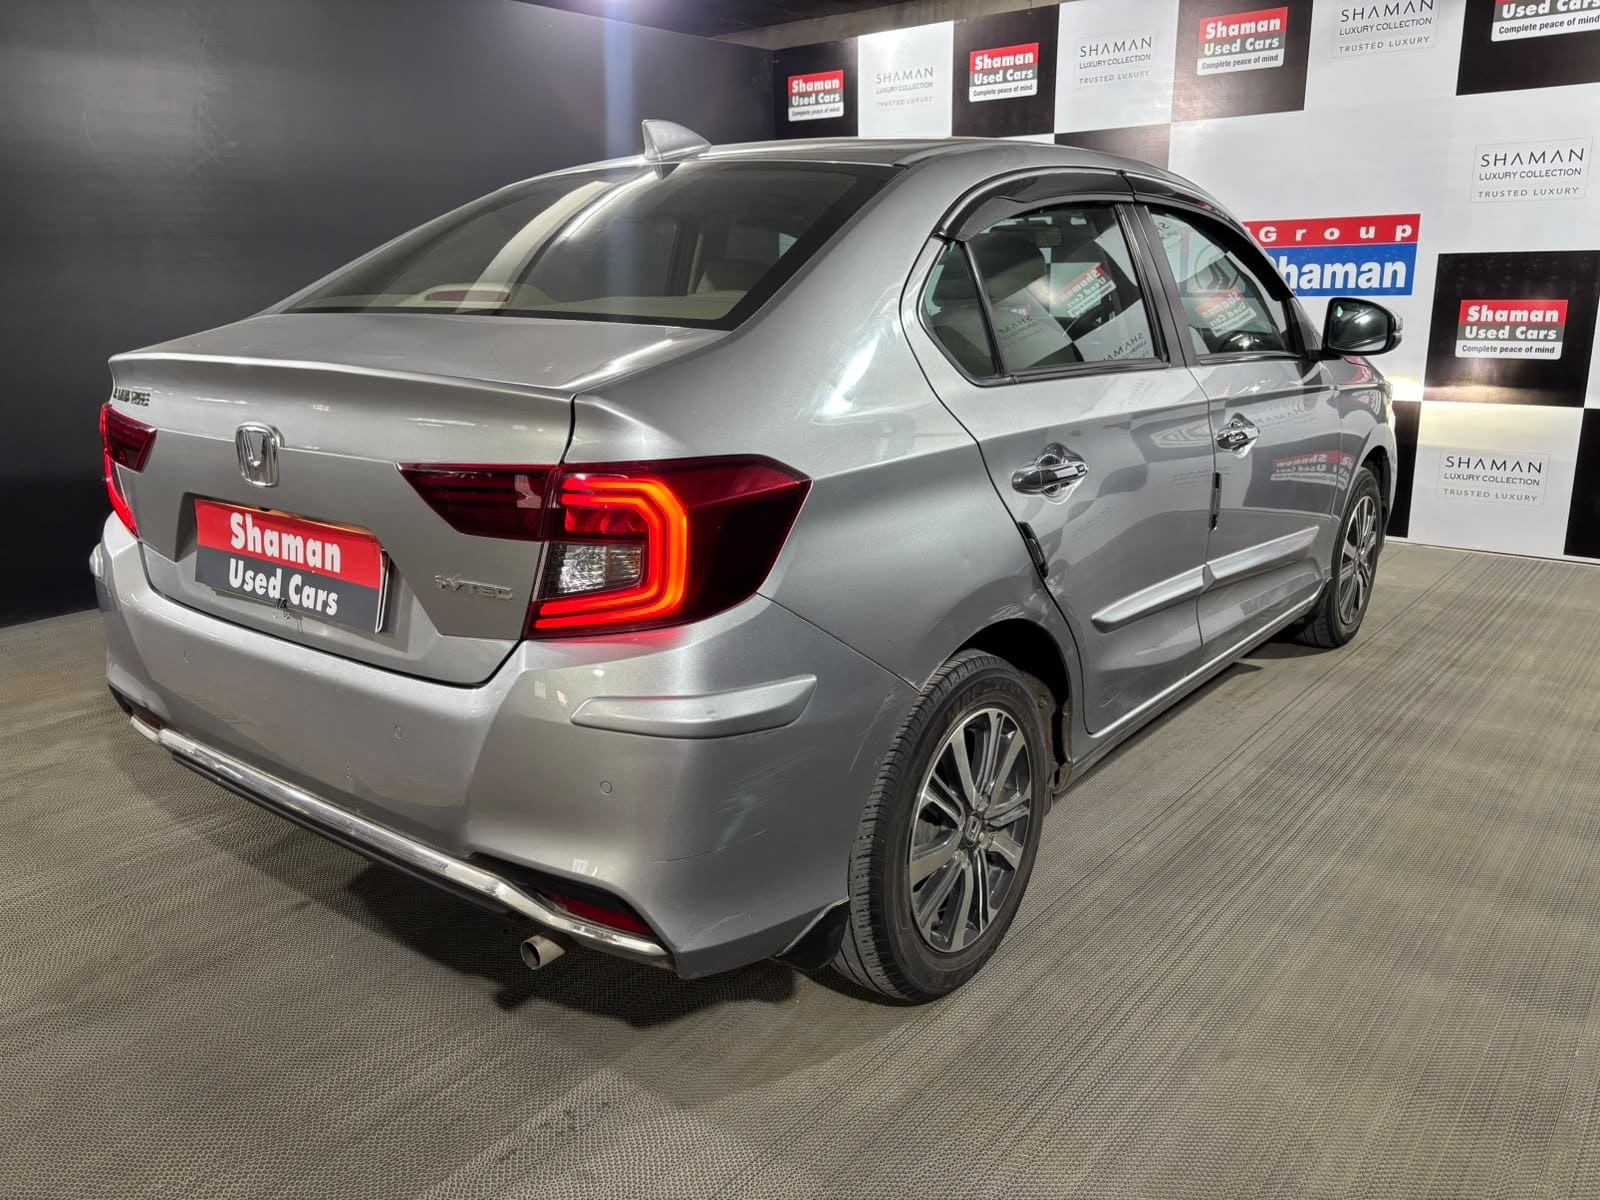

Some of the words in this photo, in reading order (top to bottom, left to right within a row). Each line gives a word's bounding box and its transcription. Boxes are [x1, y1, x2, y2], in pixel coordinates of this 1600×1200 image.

[1340, 0, 1434, 23] SHAMAN
[1502, 0, 1550, 19] Used
[1205, 18, 1281, 40] Shaman
[1339, 24, 1375, 36] LUXURY
[1376, 17, 1432, 31] COLLECTION
[1499, 23, 1538, 35] Complete
[1539, 20, 1565, 31] peace
[1567, 17, 1576, 26] of
[1578, 15, 1600, 25] mind
[1080, 36, 1152, 58] SHAMAN
[1204, 38, 1240, 56] Used
[1245, 37, 1280, 51] Cars
[1338, 41, 1384, 53] TRUSTED
[1389, 35, 1430, 48] LUXURY
[975, 52, 1034, 70] Shaman
[1080, 60, 1106, 69] LUXURY
[1107, 53, 1151, 66] COLLECTION
[1202, 60, 1231, 70] Complete
[1232, 59, 1252, 68] peace
[1261, 54, 1279, 63] mind
[876, 66, 933, 84] SHAMAN
[974, 70, 1003, 85] Used
[1007, 69, 1033, 81] Cars
[1080, 75, 1114, 84] TRUSTED
[1117, 71, 1150, 81] LUXURY
[792, 78, 840, 93] Shaman
[997, 86, 1012, 95] peace
[1013, 84, 1020, 92] of
[792, 93, 816, 106] Used
[818, 92, 840, 103] Cars
[1480, 148, 1584, 167] SHAMAN
[1479, 171, 1518, 181] LUXURY
[1519, 168, 1582, 179] COLLECTION
[1478, 189, 1528, 198] TRUSTED
[1533, 187, 1578, 196] LUXURY
[1258, 224, 1412, 243] Group
[1271, 255, 1407, 290] haman
[1467, 305, 1559, 323] Shaman
[1465, 325, 1510, 339] Used
[1515, 326, 1557, 340] Cars
[1462, 345, 1497, 353] Complete
[1499, 346, 1522, 354] peace
[1445, 456, 1542, 474] SHAMAN
[1444, 472, 1480, 481] LUXURY
[1482, 475, 1540, 486] COLLECTION
[1443, 488, 1490, 498] TRUSTED
[1495, 492, 1537, 502] LUXURY
[230, 512, 341, 573] Shaman
[229, 558, 282, 599] Used
[289, 574, 339, 616] Cars
